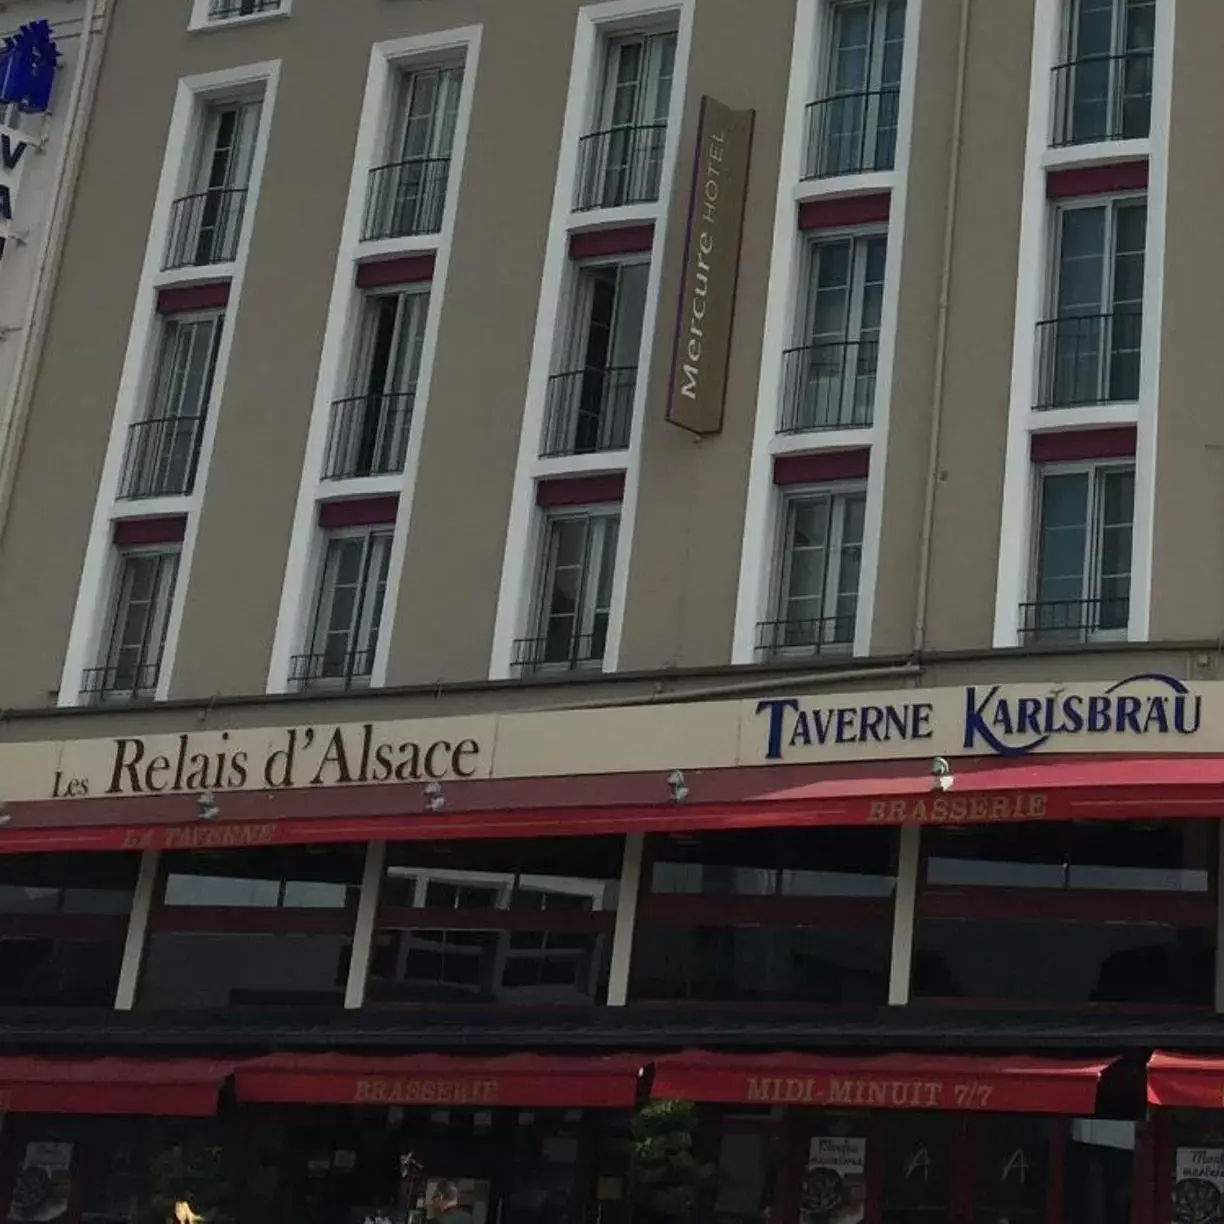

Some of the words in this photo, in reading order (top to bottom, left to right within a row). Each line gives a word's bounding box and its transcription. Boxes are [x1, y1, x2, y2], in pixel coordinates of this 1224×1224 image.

[680, 232, 714, 400] Mercure
[702, 132, 725, 223] HOTEL
[52, 771, 89, 797] Les
[105, 732, 249, 794] Relais
[264, 724, 480, 788] d'Alsace
[866, 793, 1050, 823] BRASSERIE
[353, 1079, 499, 1104] BRASSERIE
[745, 1078, 944, 1106] MIDI-MINUIT
[954, 1082, 993, 1108] 7/7
